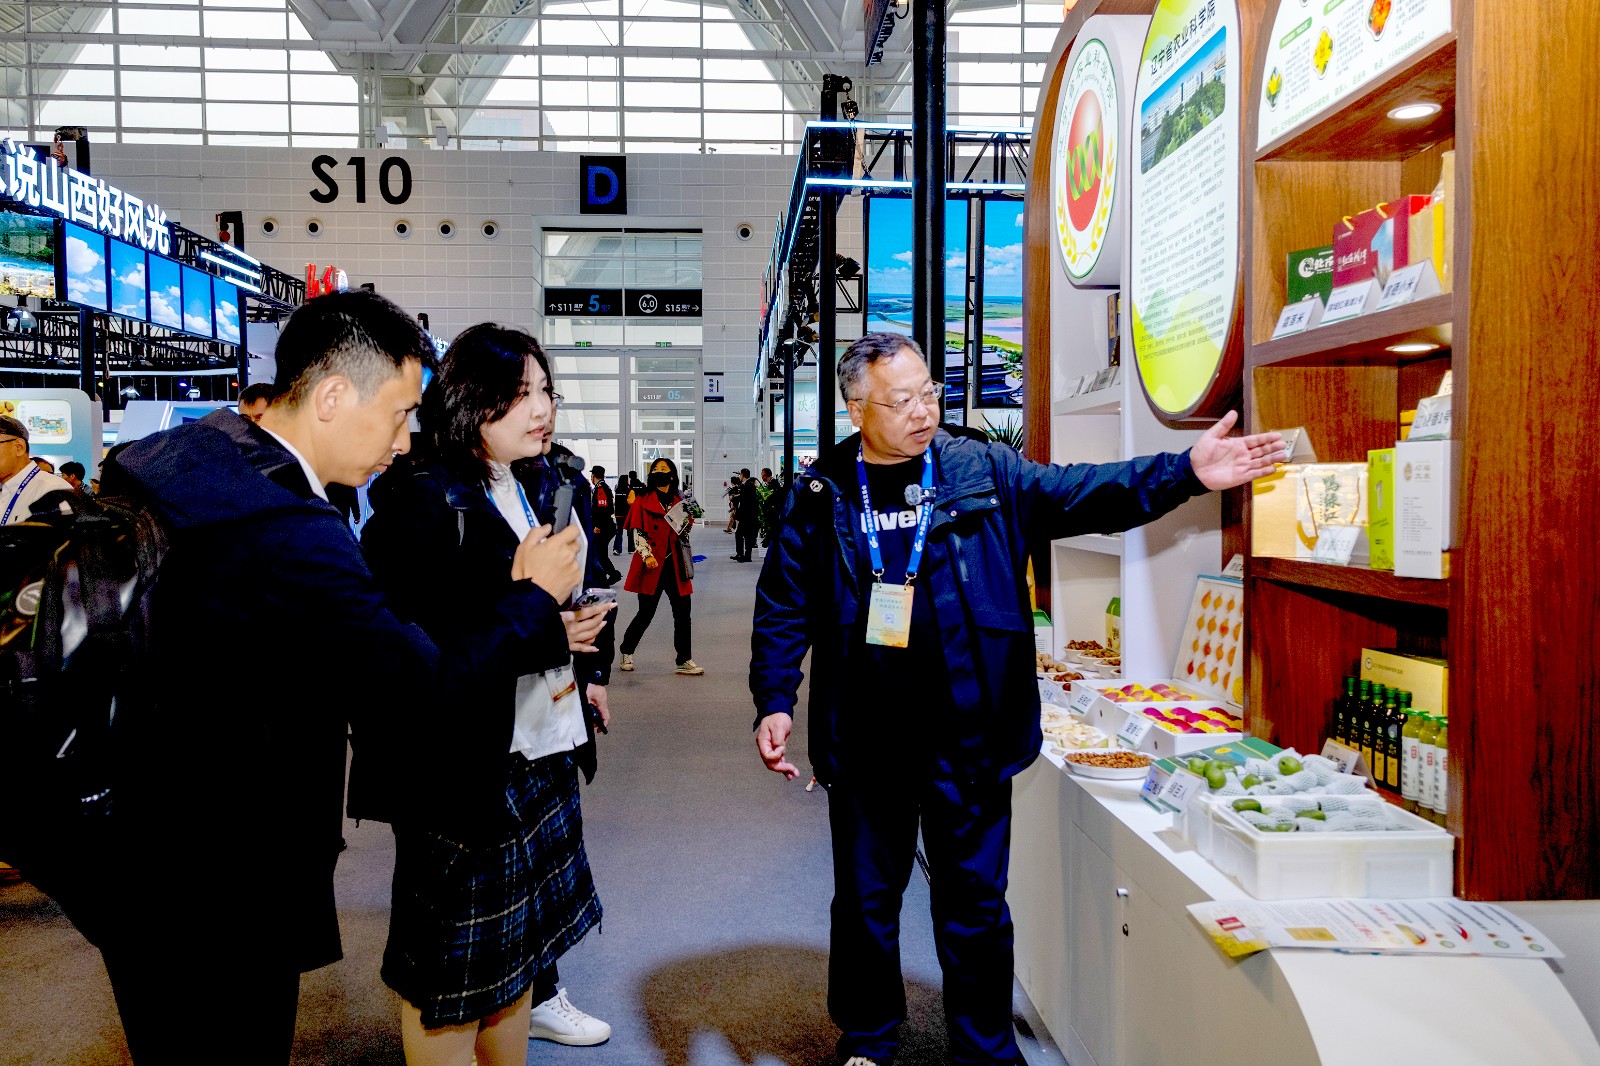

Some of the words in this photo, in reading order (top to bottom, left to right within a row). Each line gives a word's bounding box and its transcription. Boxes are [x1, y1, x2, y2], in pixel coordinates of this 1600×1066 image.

[1150, 0, 1216, 75] 辽宁省农业科学院
[0, 137, 170, 255] 说山西好风光
[308, 154, 413, 205] S10
[587, 165, 620, 205] D
[557, 303, 572, 312] S11
[587, 294, 600, 313] 5
[642, 300, 655, 308] 6.0
[665, 304, 681, 312] S15
